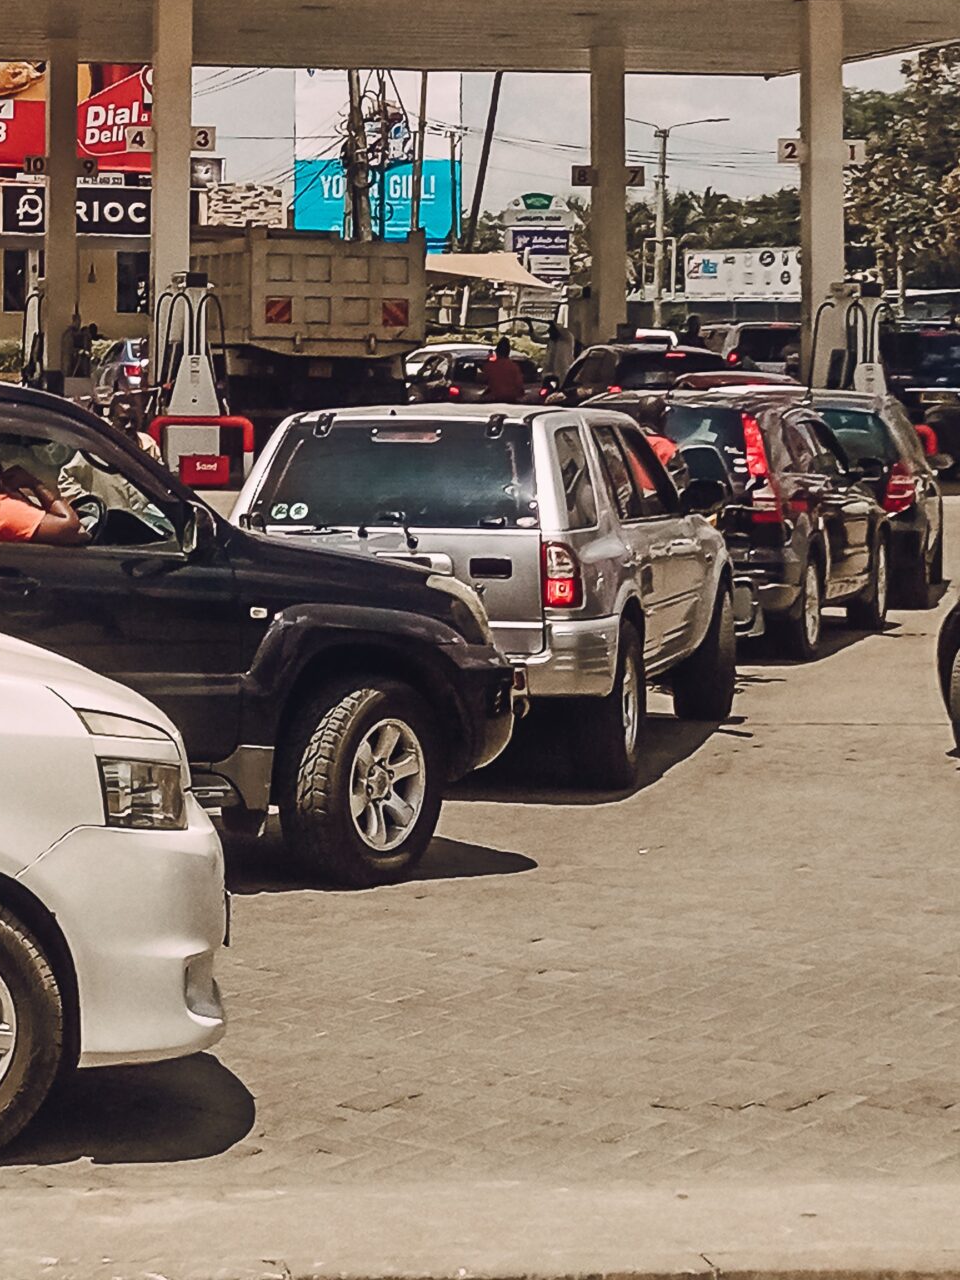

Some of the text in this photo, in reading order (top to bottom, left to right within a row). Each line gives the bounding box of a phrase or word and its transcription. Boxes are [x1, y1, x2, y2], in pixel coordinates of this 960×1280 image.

[86, 101, 139, 128] Dial
[85, 125, 125, 145] Deli
[131, 131, 145, 147] 4
[196, 130, 209, 147] 3
[784, 142, 798, 159] 2
[25, 157, 45, 172] 10
[83, 159, 94, 173] 9
[629, 170, 640, 183] 7
[76, 201, 147, 223] RIOC
[195, 461, 218, 472] Sand
